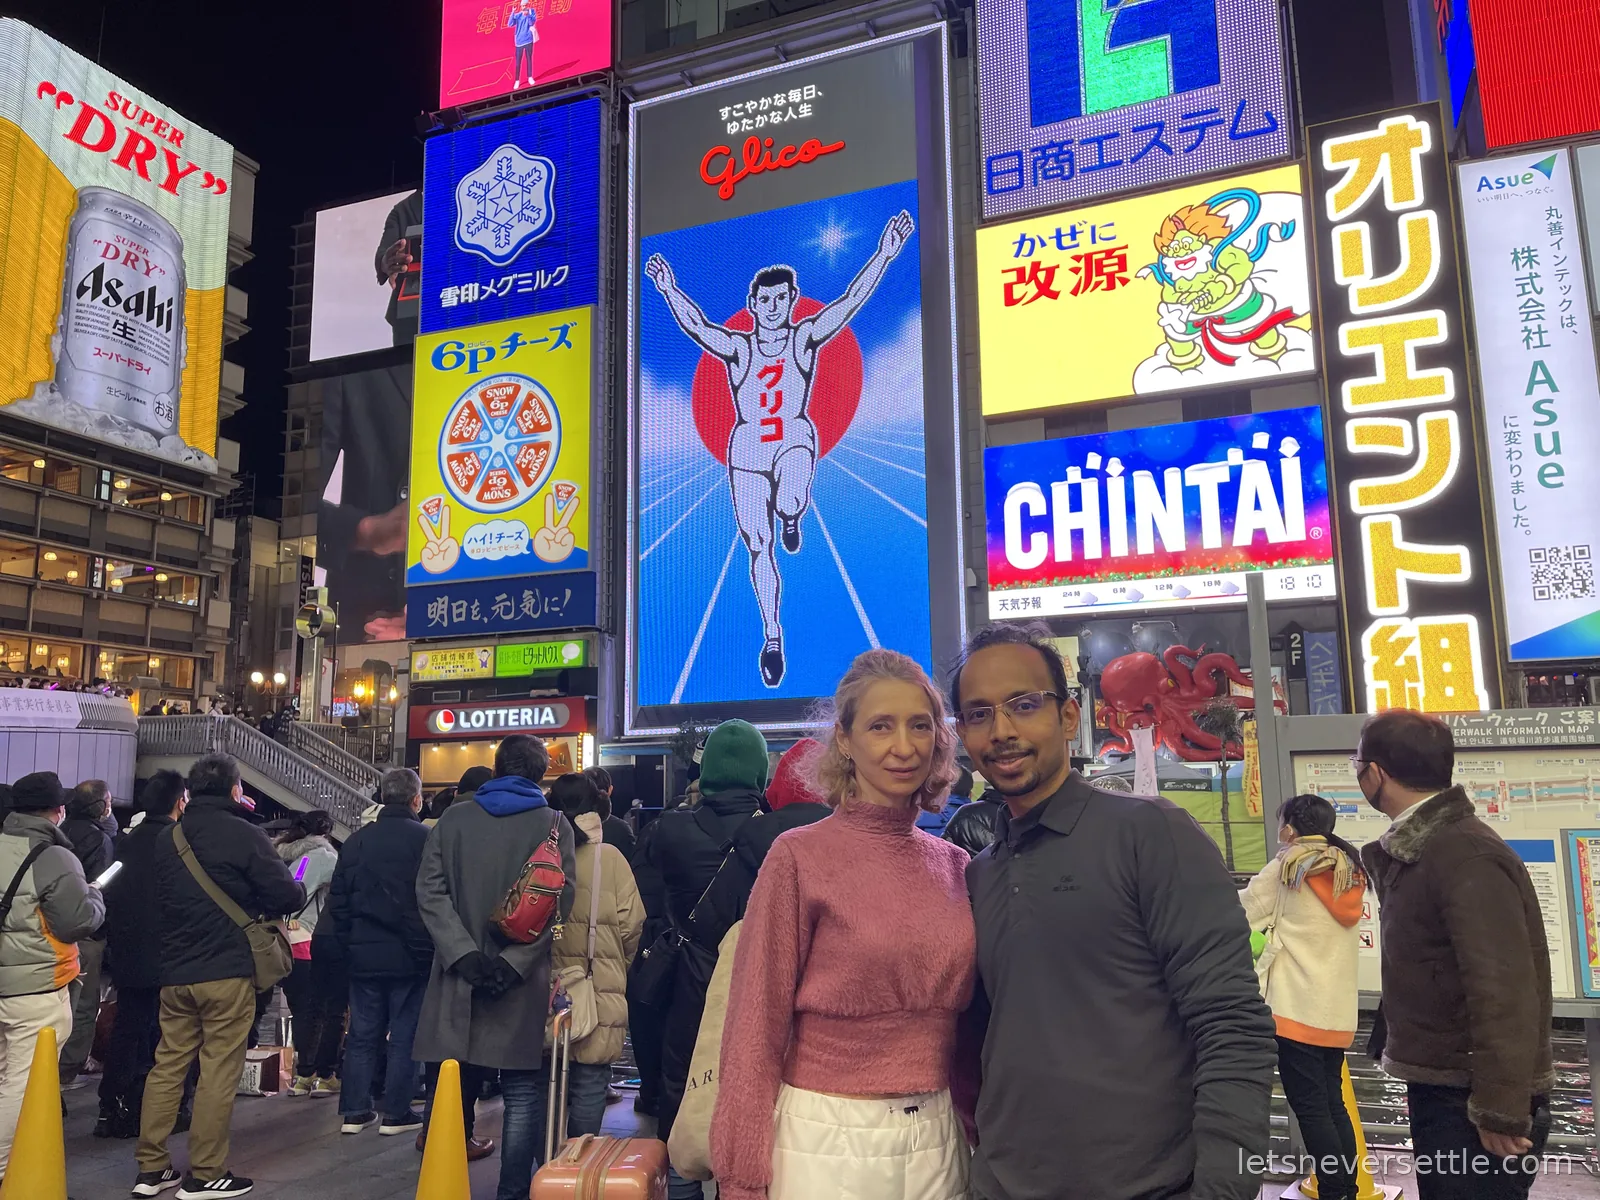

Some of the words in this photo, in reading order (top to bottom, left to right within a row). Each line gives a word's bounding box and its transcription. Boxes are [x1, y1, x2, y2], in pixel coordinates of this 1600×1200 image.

[719, 84, 823, 120] すこやかな毎日、
[104, 90, 185, 147] SUPER
[727, 104, 813, 135] ゆたかな人生
[986, 100, 1279, 195] 日商エステム
[700, 135, 845, 201] Glico
[1477, 172, 1534, 193] Asue
[114, 234, 149, 256] SUPER
[1012, 220, 1117, 259] かぜに
[1001, 244, 1131, 307] 改源
[1545, 205, 1578, 334] 丸善インテックは、
[76, 262, 173, 333] Asahi
[440, 265, 569, 308] 雪印メグミルク
[1510, 246, 1551, 350] 株式会社
[112, 319, 136, 343] 生
[93, 347, 151, 375] スーパードライ
[486, 386, 515, 398] SNOW
[757, 358, 786, 443] グリコ
[155, 400, 173, 422] お酒
[451, 406, 471, 439] SNOW
[529, 398, 549, 426] SNOW
[1525, 360, 1565, 489] Asue
[449, 460, 468, 487] SNOW
[528, 448, 547, 481] SNOW
[1503, 415, 1532, 536] に変わりました。
[482, 489, 511, 500] SNOW
[1003, 435, 1307, 570] CHINTAI
[998, 596, 1042, 611] 天気予報
[523, 645, 559, 665] ピタットハウス
[1290, 633, 1302, 665] 2F
[460, 707, 556, 728] LOTTERIA
[1453, 728, 1492, 737] ERWALK
[1497, 726, 1564, 736] INFORMATION
[1568, 725, 1590, 734] MAP
[1560, 710, 1600, 725] ご案
[687, 1068, 720, 1092] AR
